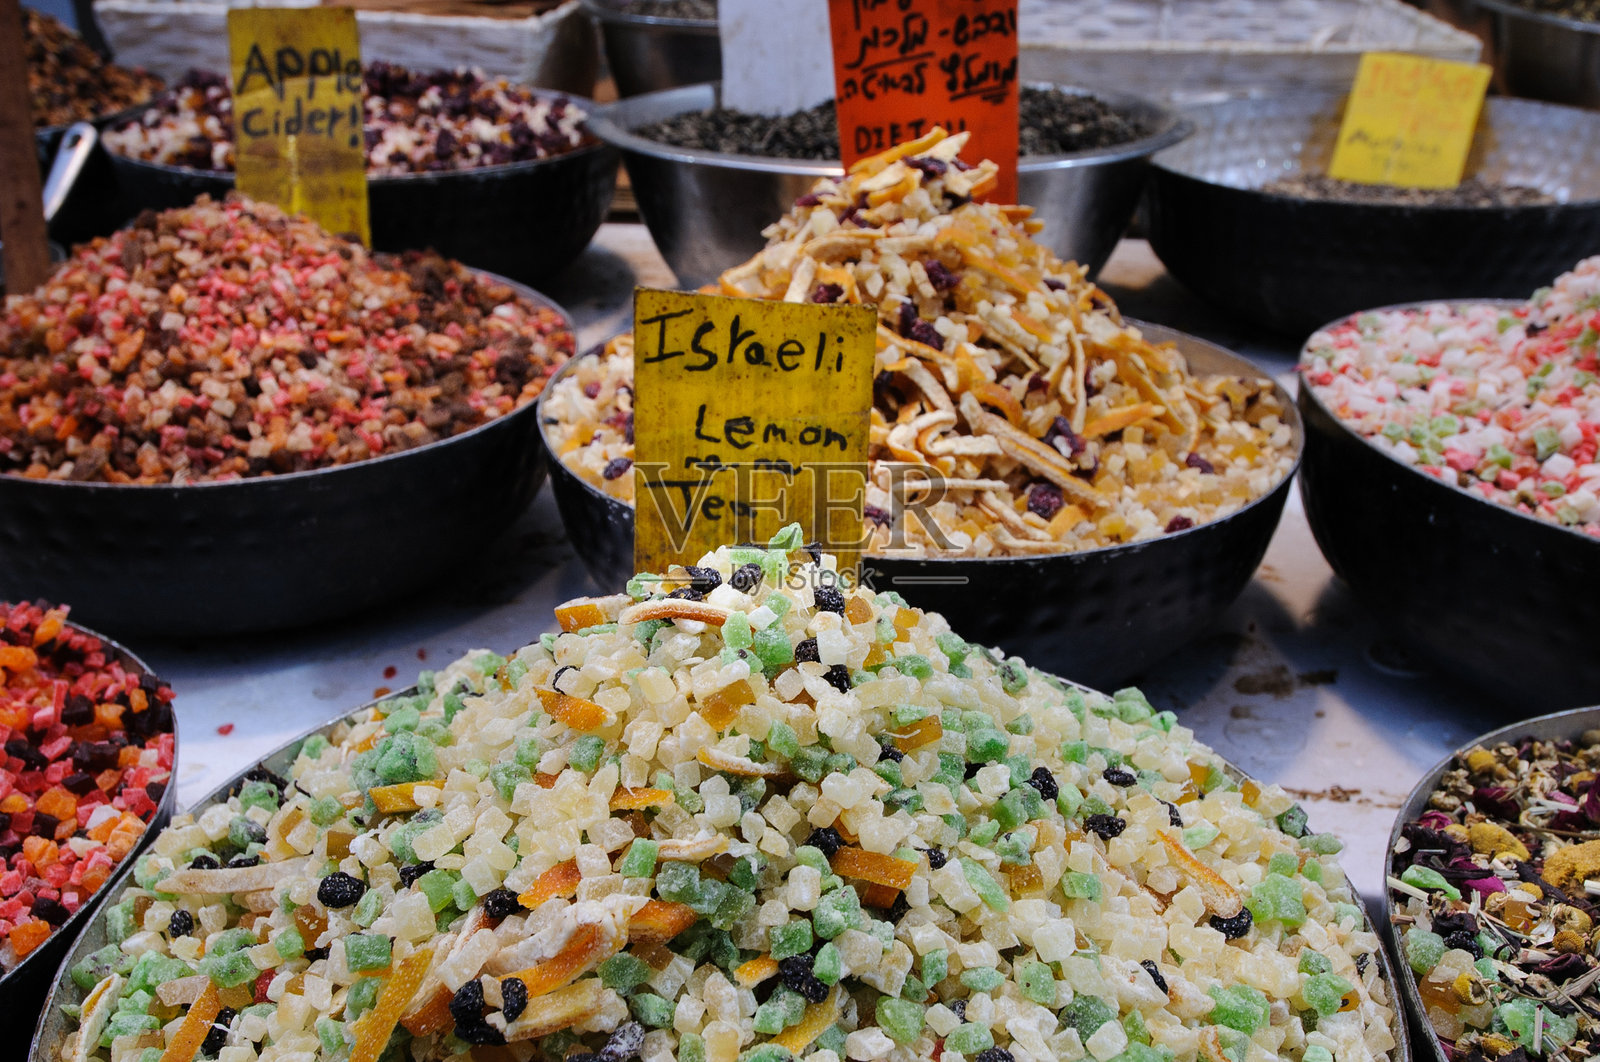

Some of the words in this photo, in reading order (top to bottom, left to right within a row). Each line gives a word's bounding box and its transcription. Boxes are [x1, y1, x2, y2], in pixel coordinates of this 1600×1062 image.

[236, 42, 363, 100] Apple
[641, 307, 845, 372] Israeli
[694, 403, 849, 450] Lemon
[643, 479, 758, 533] Tea
